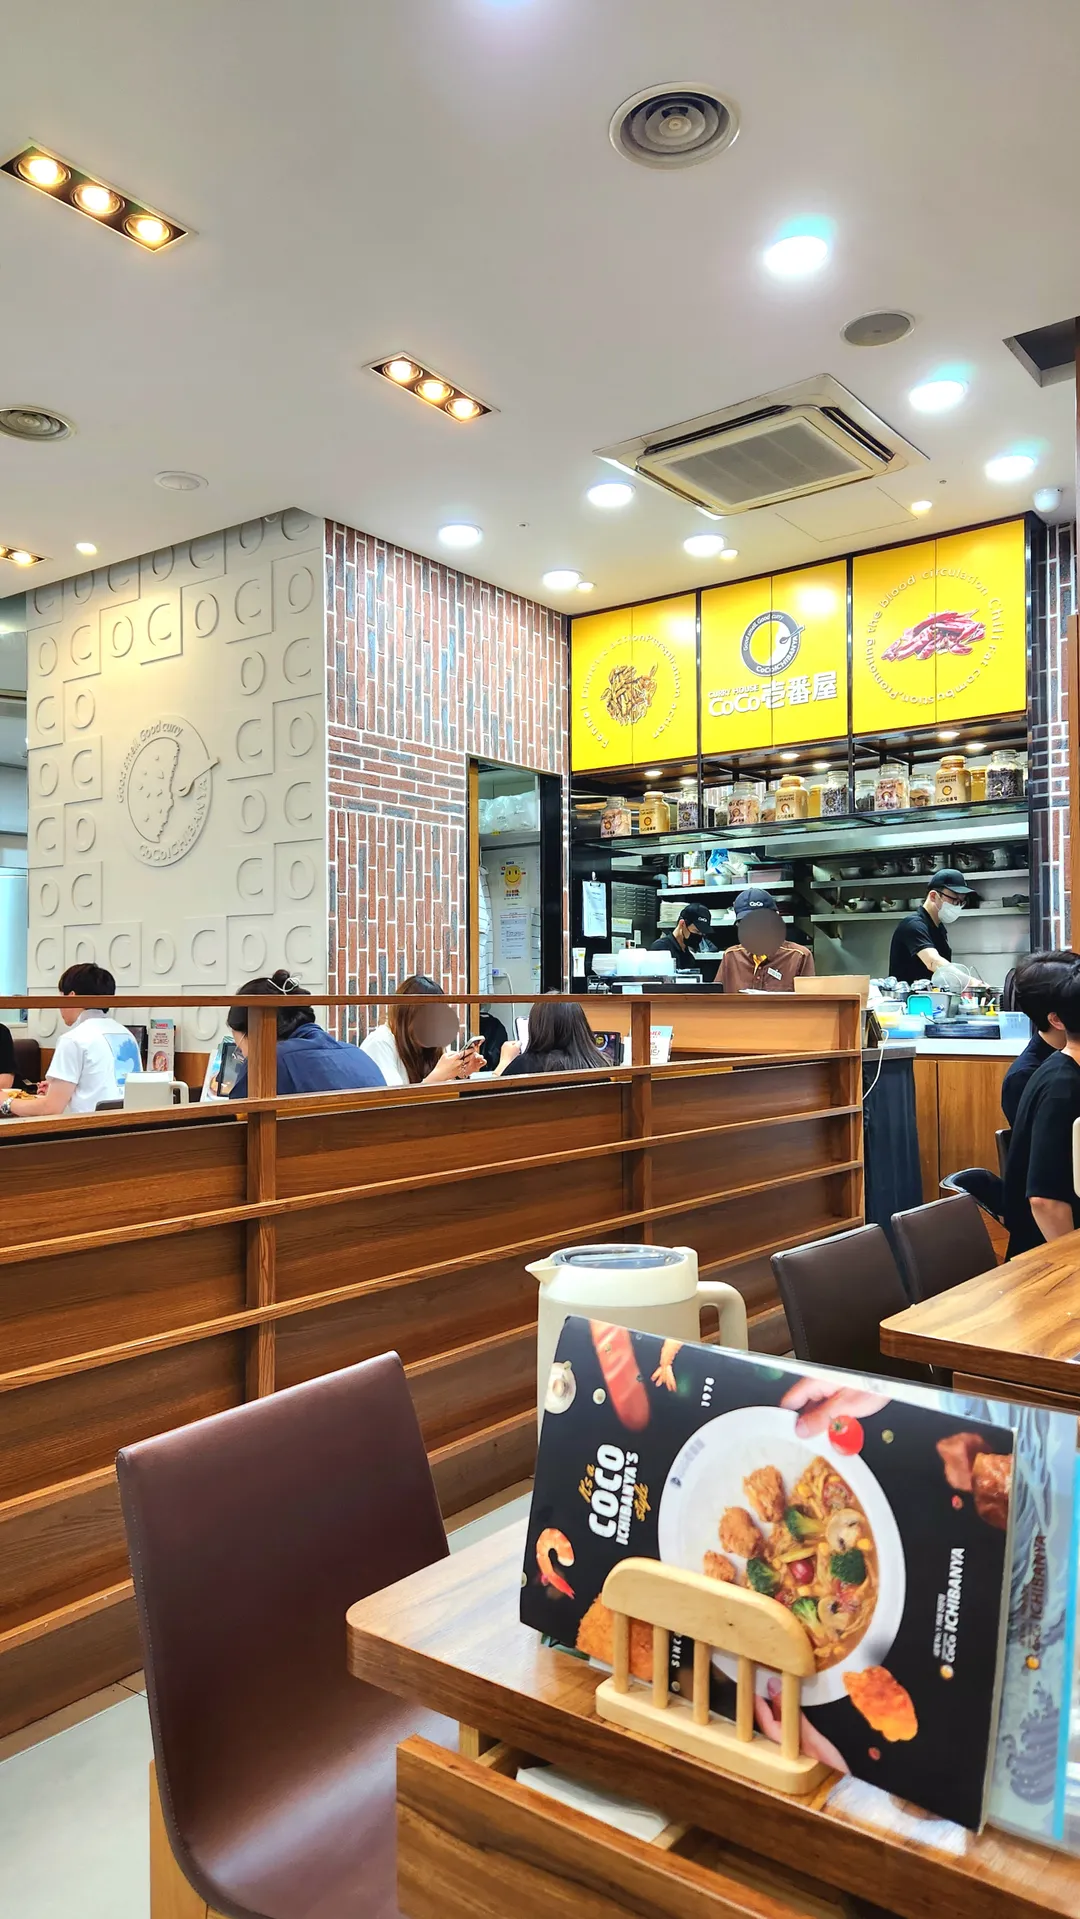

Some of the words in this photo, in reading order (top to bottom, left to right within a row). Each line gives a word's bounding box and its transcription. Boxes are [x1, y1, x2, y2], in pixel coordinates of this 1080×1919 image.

[880, 575, 916, 608] blood
[707, 689, 732, 699] CURRY
[732, 684, 760, 695] HOUSE
[139, 720, 162, 742] Good
[162, 722, 184, 738] curry
[700, 1376, 715, 1408] 1978
[586, 1463, 596, 1477] a
[588, 1443, 626, 1539] COCO
[615, 1450, 639, 1547] ICHIBANYA'S
[944, 1547, 966, 1633] ICHIBANYA
[1029, 1534, 1048, 1620] ICHIBANYA
